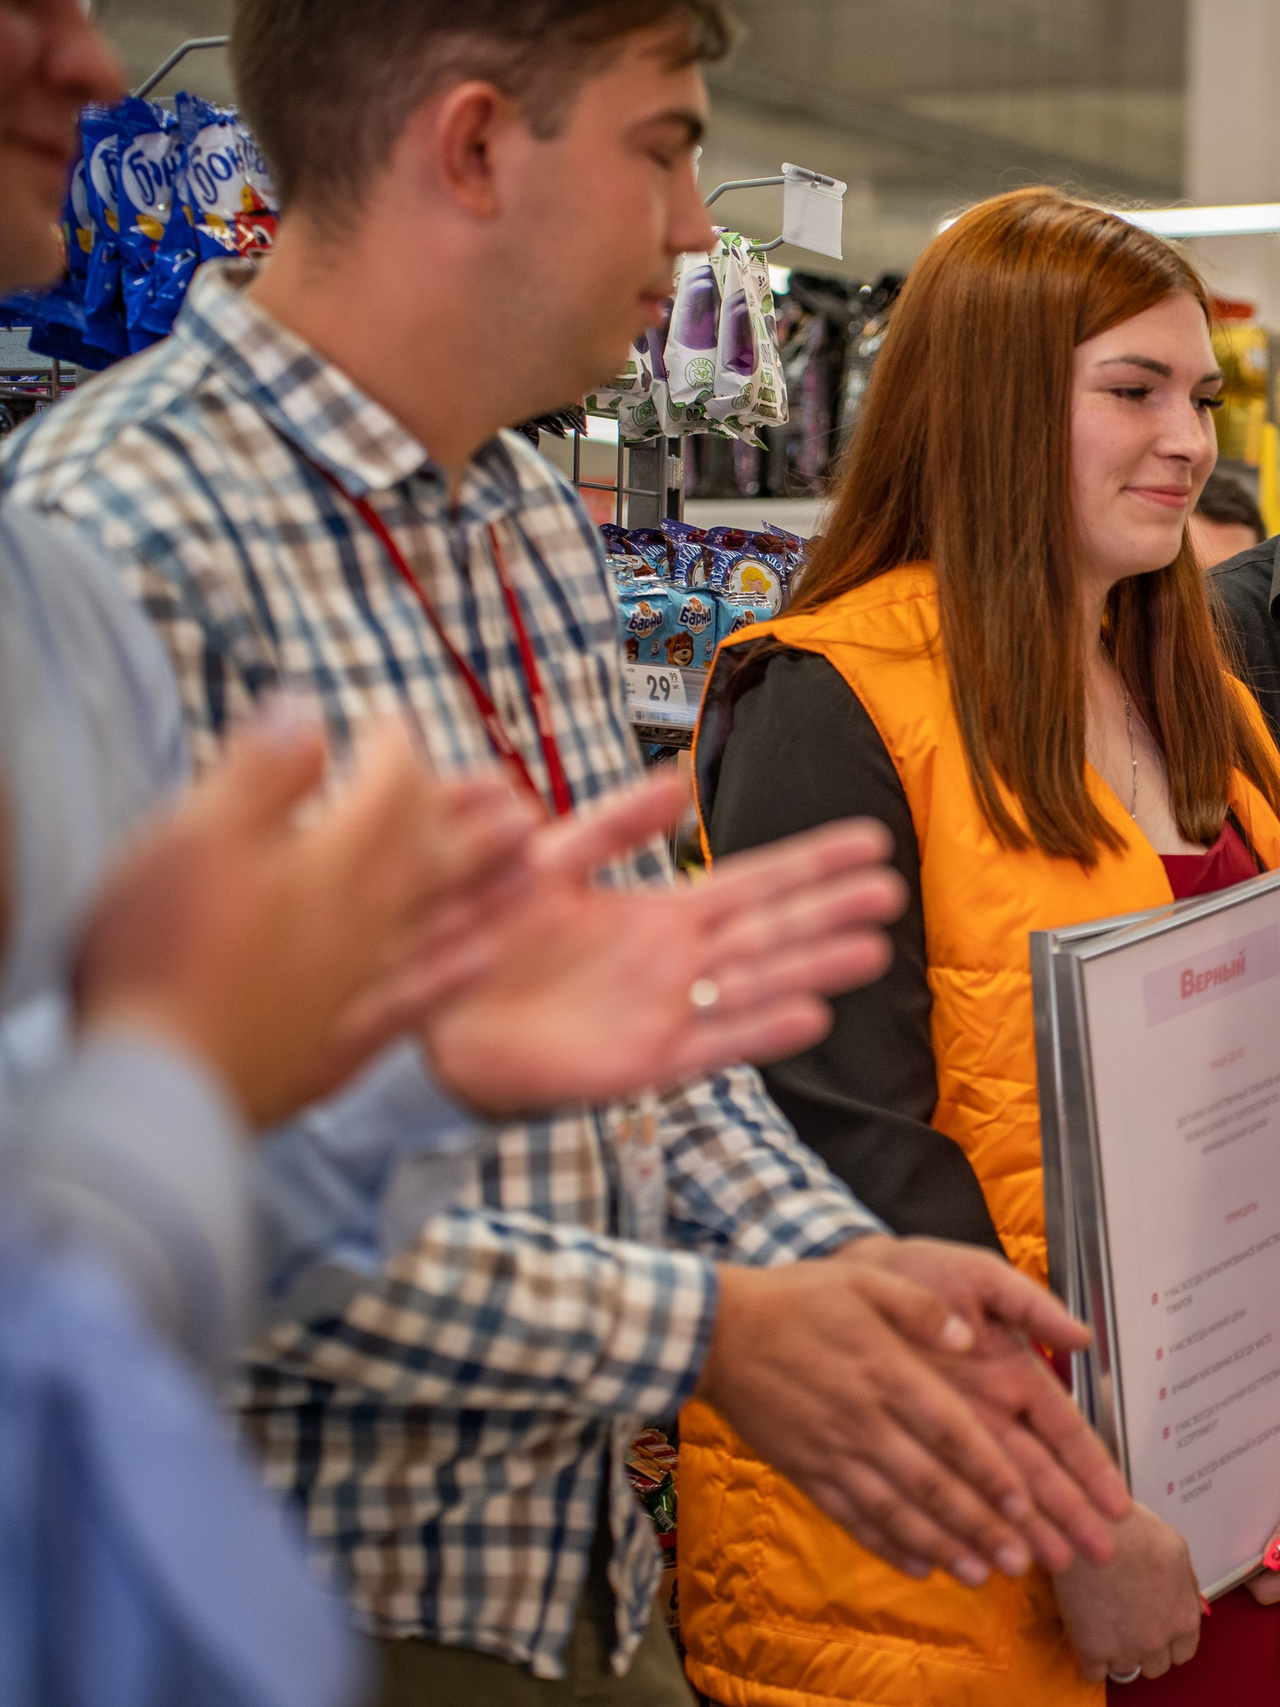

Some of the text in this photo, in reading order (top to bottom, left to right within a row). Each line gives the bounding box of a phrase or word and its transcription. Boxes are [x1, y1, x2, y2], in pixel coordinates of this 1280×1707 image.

[629, 611, 663, 631] Барни
[680, 606, 712, 626] Барни
[646, 674, 671, 702] 29
